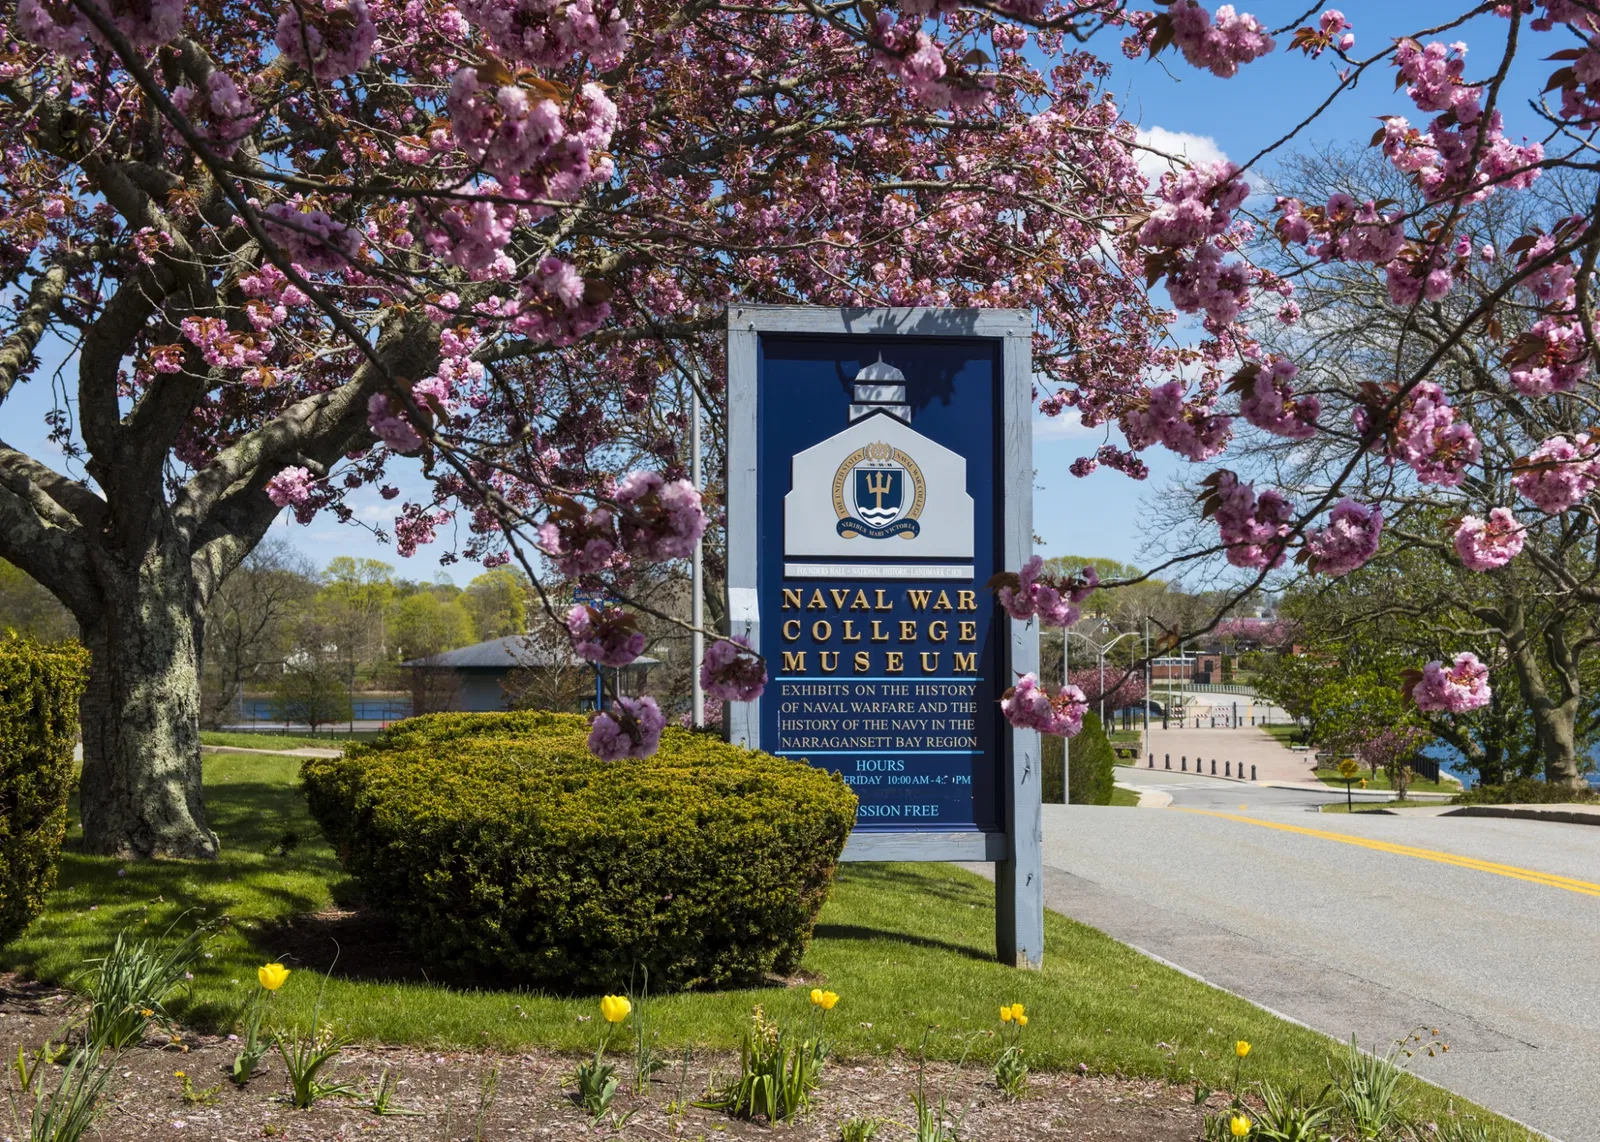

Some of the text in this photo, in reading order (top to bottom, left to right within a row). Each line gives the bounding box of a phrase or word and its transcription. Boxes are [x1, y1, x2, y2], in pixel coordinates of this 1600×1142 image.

[842, 453, 863, 472] STATES
[896, 452, 914, 468] NAVAL
[912, 469, 922, 485] WAR
[835, 472, 845, 499] UNITED
[912, 485, 924, 518] COLLEGE
[885, 522, 915, 534] VICTORIA
[852, 567, 881, 576] NATIONAL
[781, 588, 978, 611] NAVAL WAR
[782, 619, 977, 641] COLLEGE
[781, 651, 978, 672] MUSEUM
[781, 684, 977, 696] EXHIBITS ON THE HISTORY
[781, 702, 978, 713] OF NAVAL WARFARE AND THE
[781, 719, 975, 731] HISTORY OF THE NAVY IN THE
[781, 736, 978, 748] NARRAGANSETT BAY REGION
[856, 760, 905, 772] HOURS
[843, 775, 882, 785] FRIDAY
[855, 805, 940, 817] ISSION FREE
